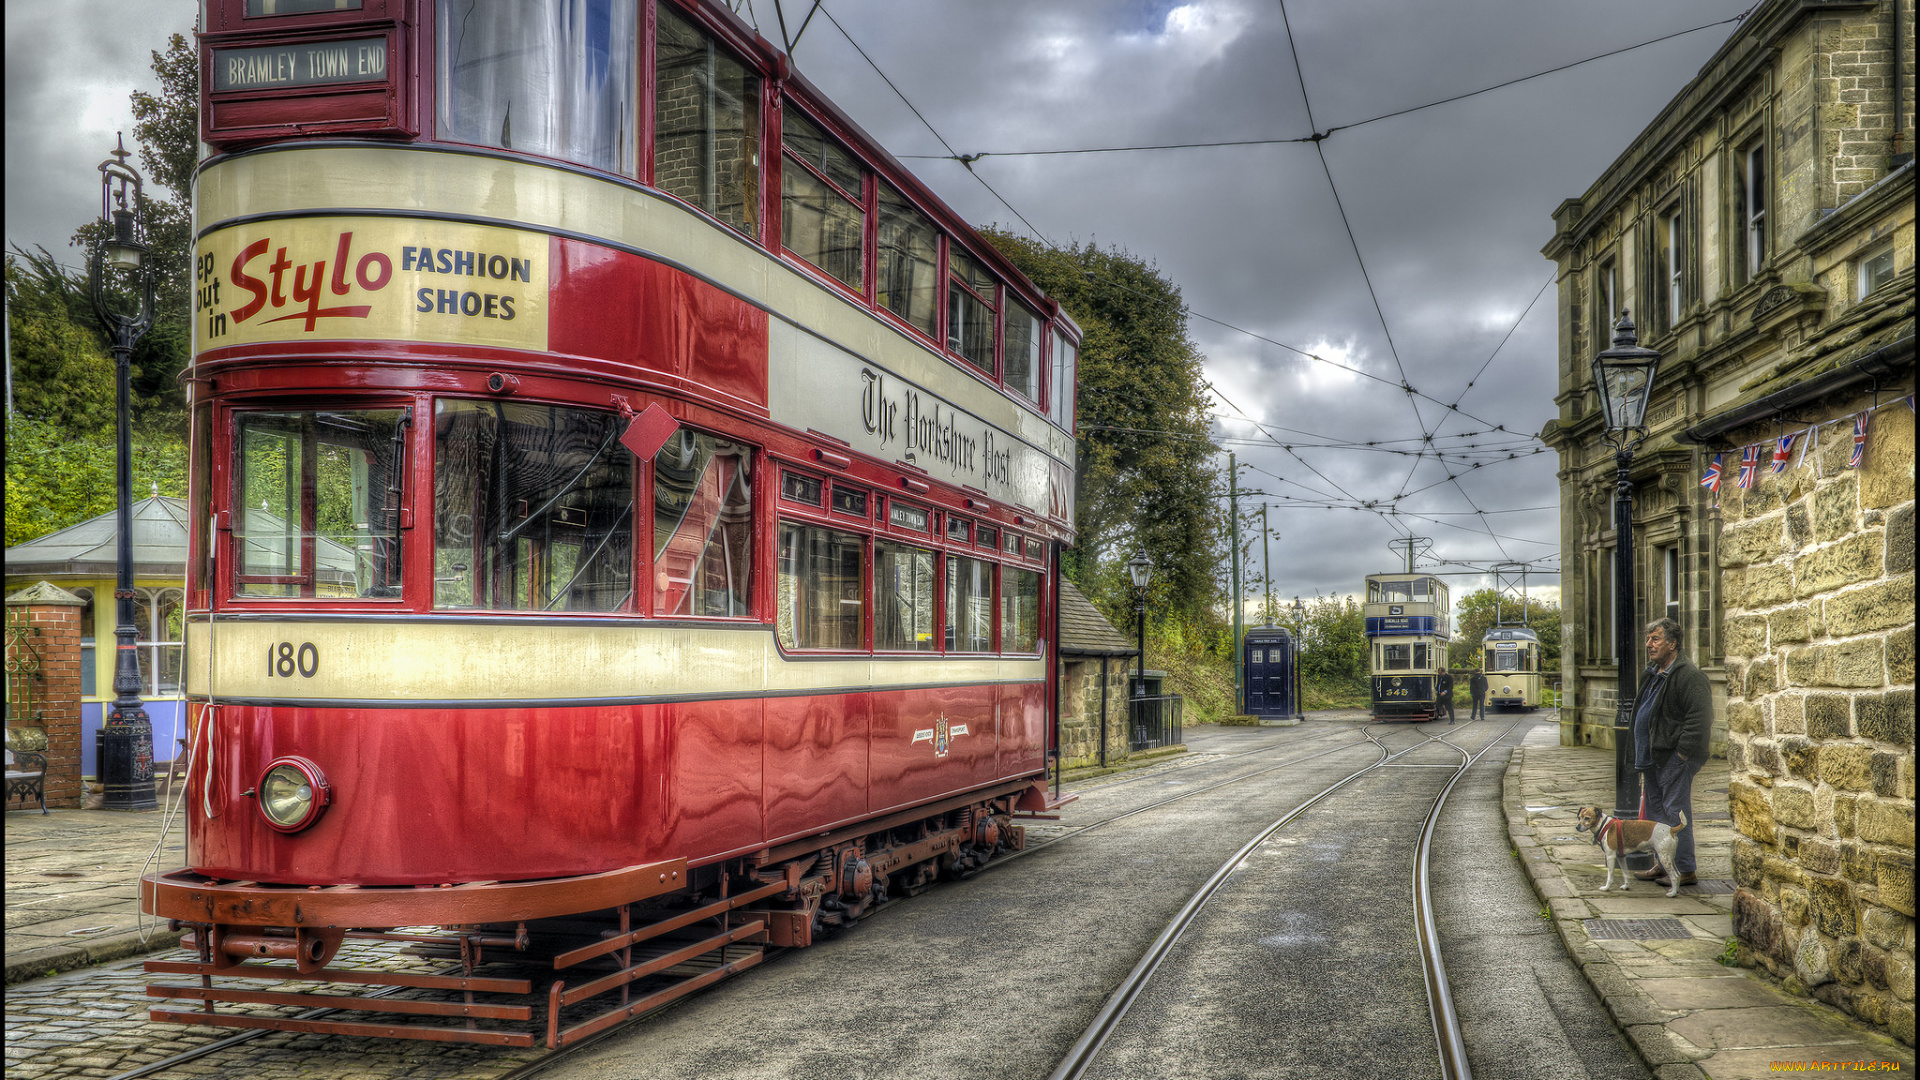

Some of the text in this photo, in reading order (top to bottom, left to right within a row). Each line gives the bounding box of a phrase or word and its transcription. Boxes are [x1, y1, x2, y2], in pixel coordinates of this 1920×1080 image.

[228, 45, 385, 85] BRAMLEY TOWN END
[230, 231, 393, 332] Stylo
[402, 246, 530, 283] FASHION
[197, 277, 220, 312] out
[416, 288, 516, 320] SHOES
[209, 308, 226, 339] in
[861, 367, 1010, 489] The Yorkshire Post
[268, 642, 319, 678] 180
[1386, 688, 1408, 697] 345
